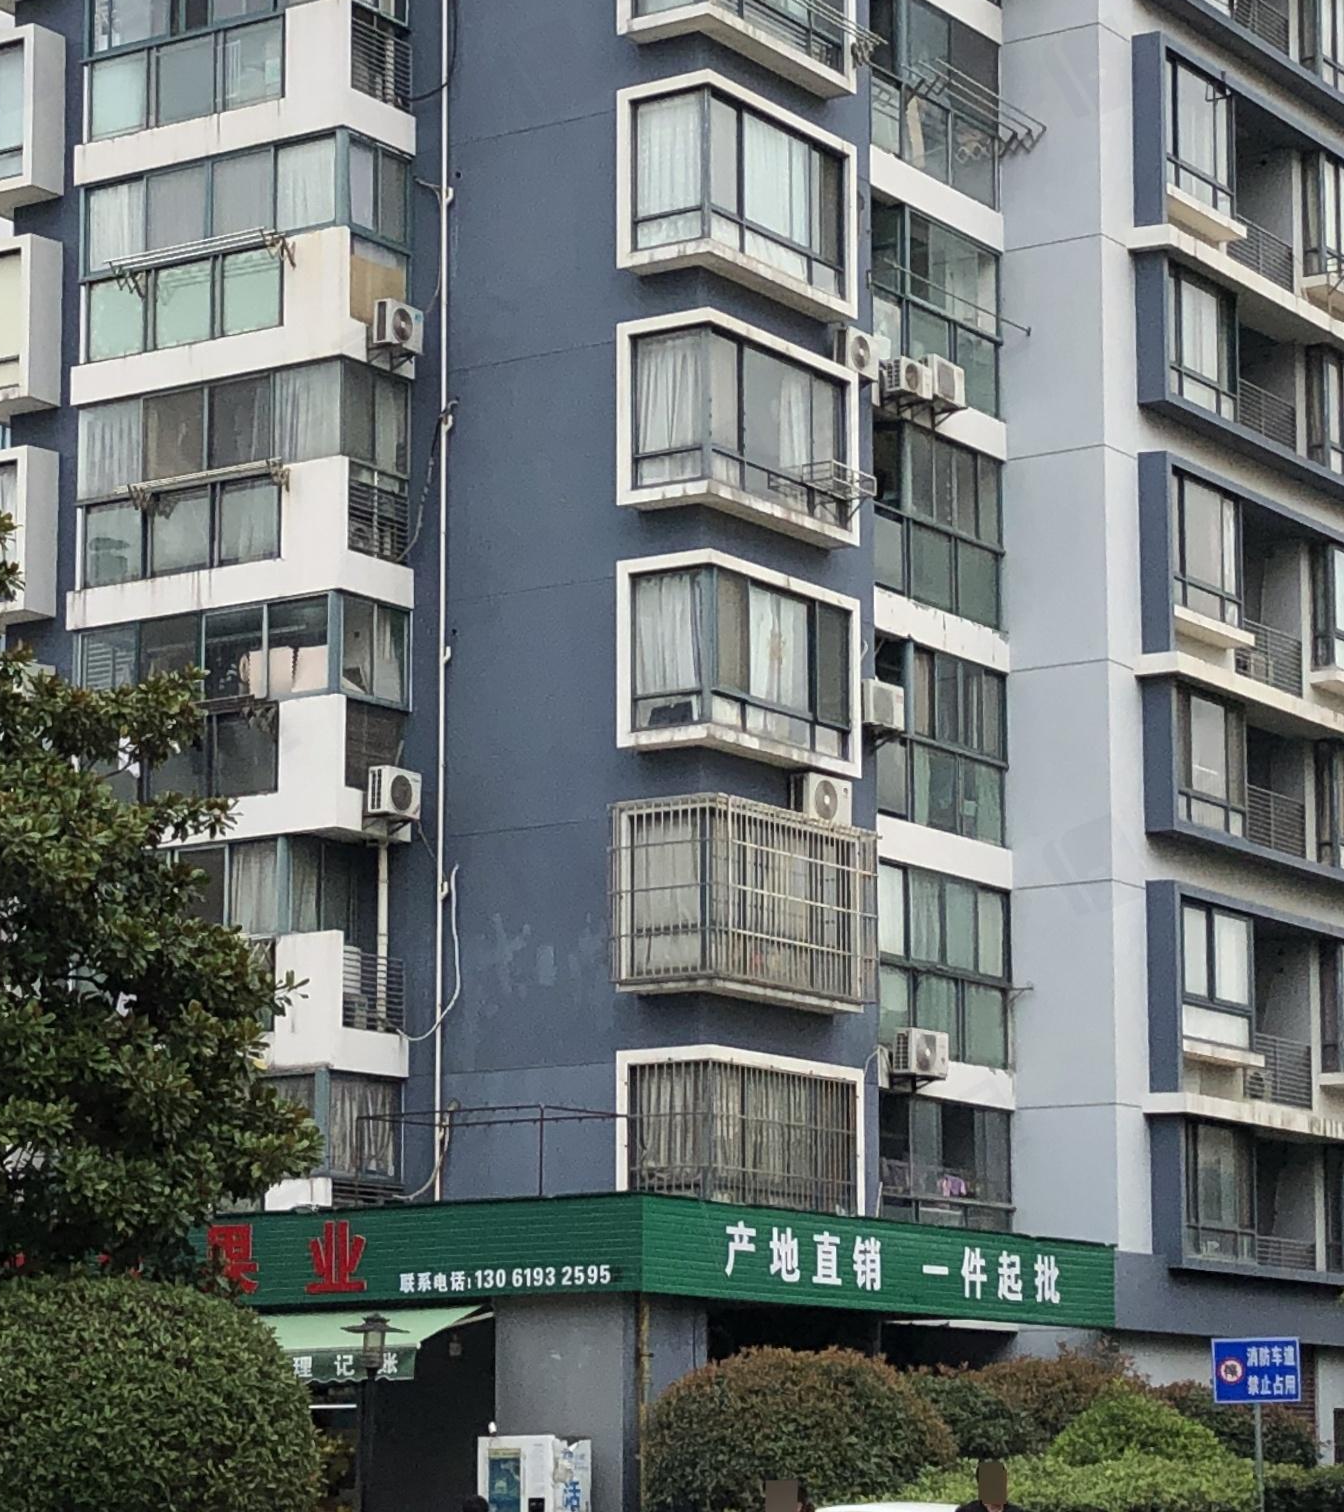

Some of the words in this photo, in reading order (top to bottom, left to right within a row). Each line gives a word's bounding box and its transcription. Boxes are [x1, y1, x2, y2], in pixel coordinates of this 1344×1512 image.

[724, 1220, 882, 1291] 产地直销
[922, 1246, 1061, 1304] 一件起批
[512, 1267, 556, 1288] 6193
[561, 1264, 611, 1285] 2595
[1247, 1374, 1296, 1396] 禁止占用
